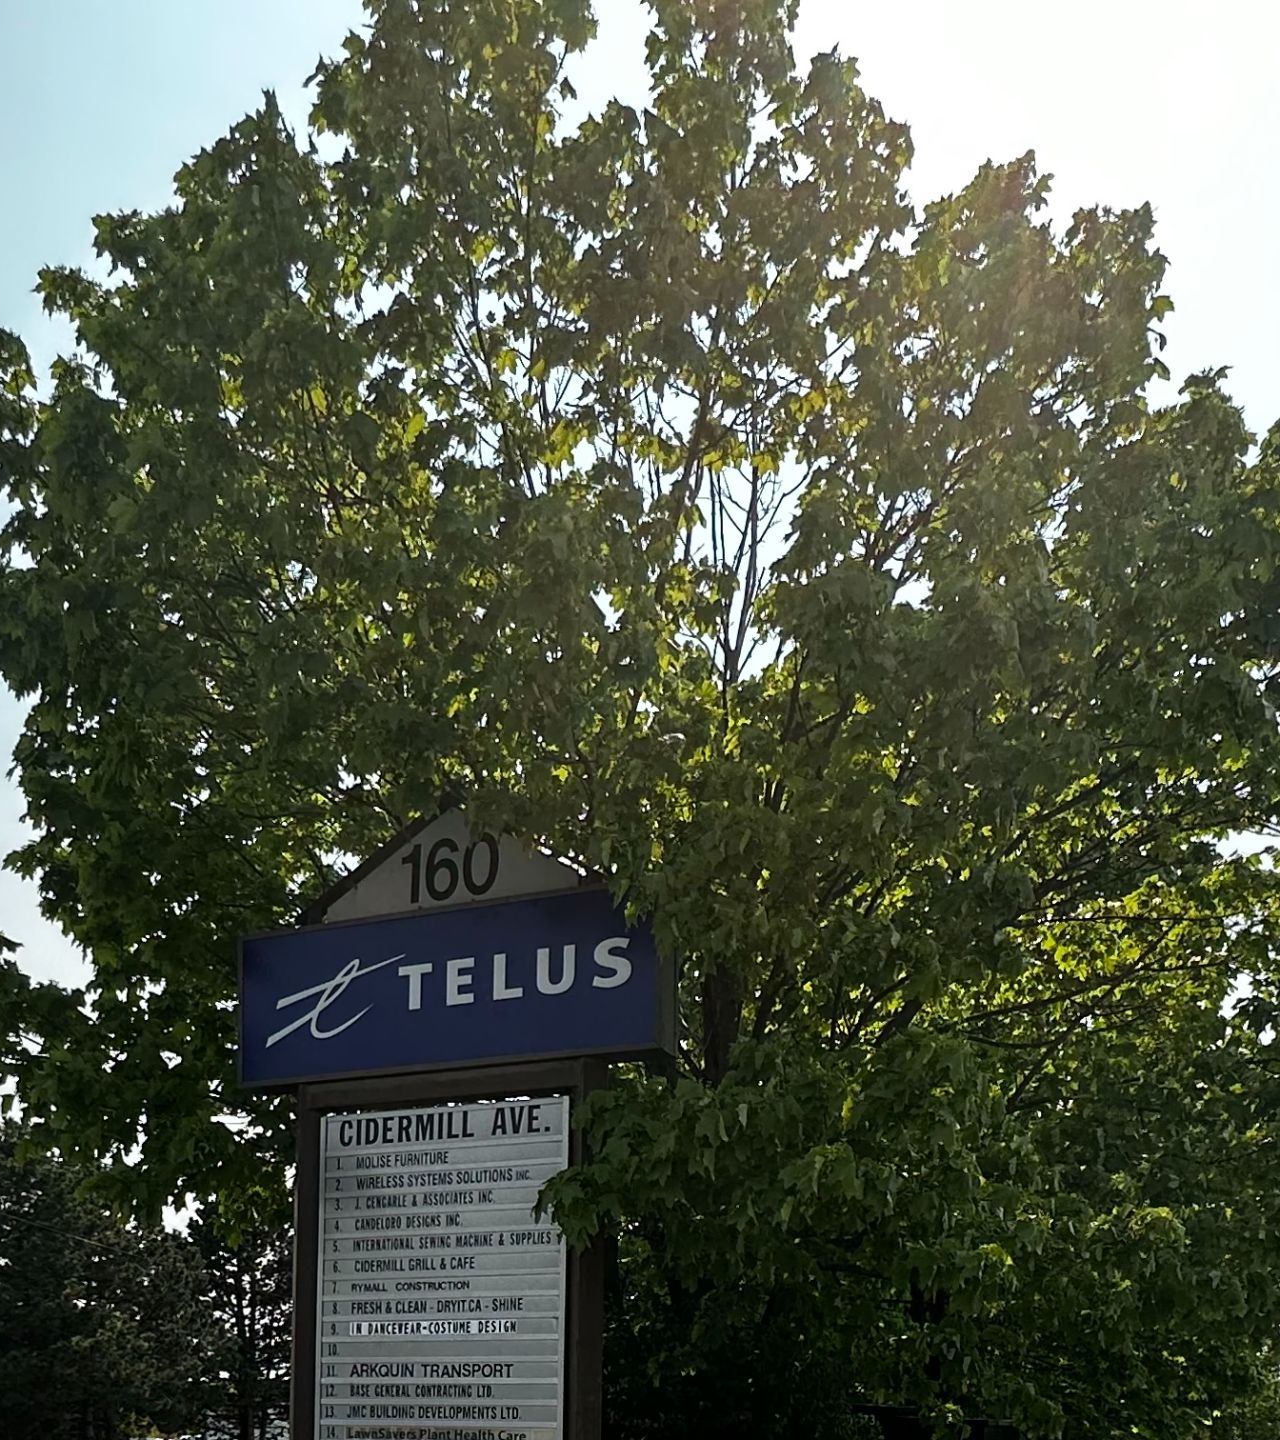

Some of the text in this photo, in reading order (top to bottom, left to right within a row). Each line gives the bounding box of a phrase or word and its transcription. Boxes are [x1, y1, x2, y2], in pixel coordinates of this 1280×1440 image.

[402, 833, 499, 904] 160
[398, 937, 632, 1010] TELUS
[339, 1105, 550, 1147] CIDERMILL AVE.
[356, 1155, 392, 1170] MOLISE
[395, 1151, 449, 1167] FURNITURE
[356, 1175, 404, 1191] WIRELESS
[407, 1171, 453, 1187] SYSTEMS
[456, 1168, 513, 1184] SOLUTIONS
[412, 1194, 417, 1206] &
[423, 1191, 473, 1206] ASSOCIATES
[406, 1214, 441, 1228] DESIGNS
[353, 1237, 414, 1252] INTERNATIONAL
[419, 1235, 451, 1249] SEWING
[456, 1233, 493, 1248] MACHINE
[498, 1232, 505, 1246] &
[510, 1231, 551, 1245] SUPPLIES
[354, 1259, 405, 1273] CIDERMILL
[408, 1257, 436, 1271] GRILL
[440, 1258, 446, 1270] &
[450, 1256, 475, 1270] CAFE
[395, 1280, 470, 1291] CONSTRUCTION
[351, 1301, 382, 1315] FRESH
[385, 1301, 392, 1313] &
[396, 1300, 427, 1314] CLEAN
[492, 1298, 523, 1311] SHINE
[351, 1323, 362, 1334] IN
[478, 1320, 516, 1333] DESIGN
[350, 1363, 415, 1378] ARKQUIN
[421, 1363, 514, 1378] TRANSPORT
[350, 1384, 370, 1397] BASE
[375, 1384, 410, 1397] GENERAL
[415, 1384, 472, 1398] CONTRACTING
[347, 1405, 367, 1418] JMC
[370, 1405, 415, 1419] BUILDING
[418, 1406, 497, 1419] DEVELOPMENTS
[501, 1407, 521, 1419] LTD.
[347, 1427, 416, 1439] LawnSavers
[420, 1428, 451, 1440] Plant
[455, 1429, 494, 1440] Health
